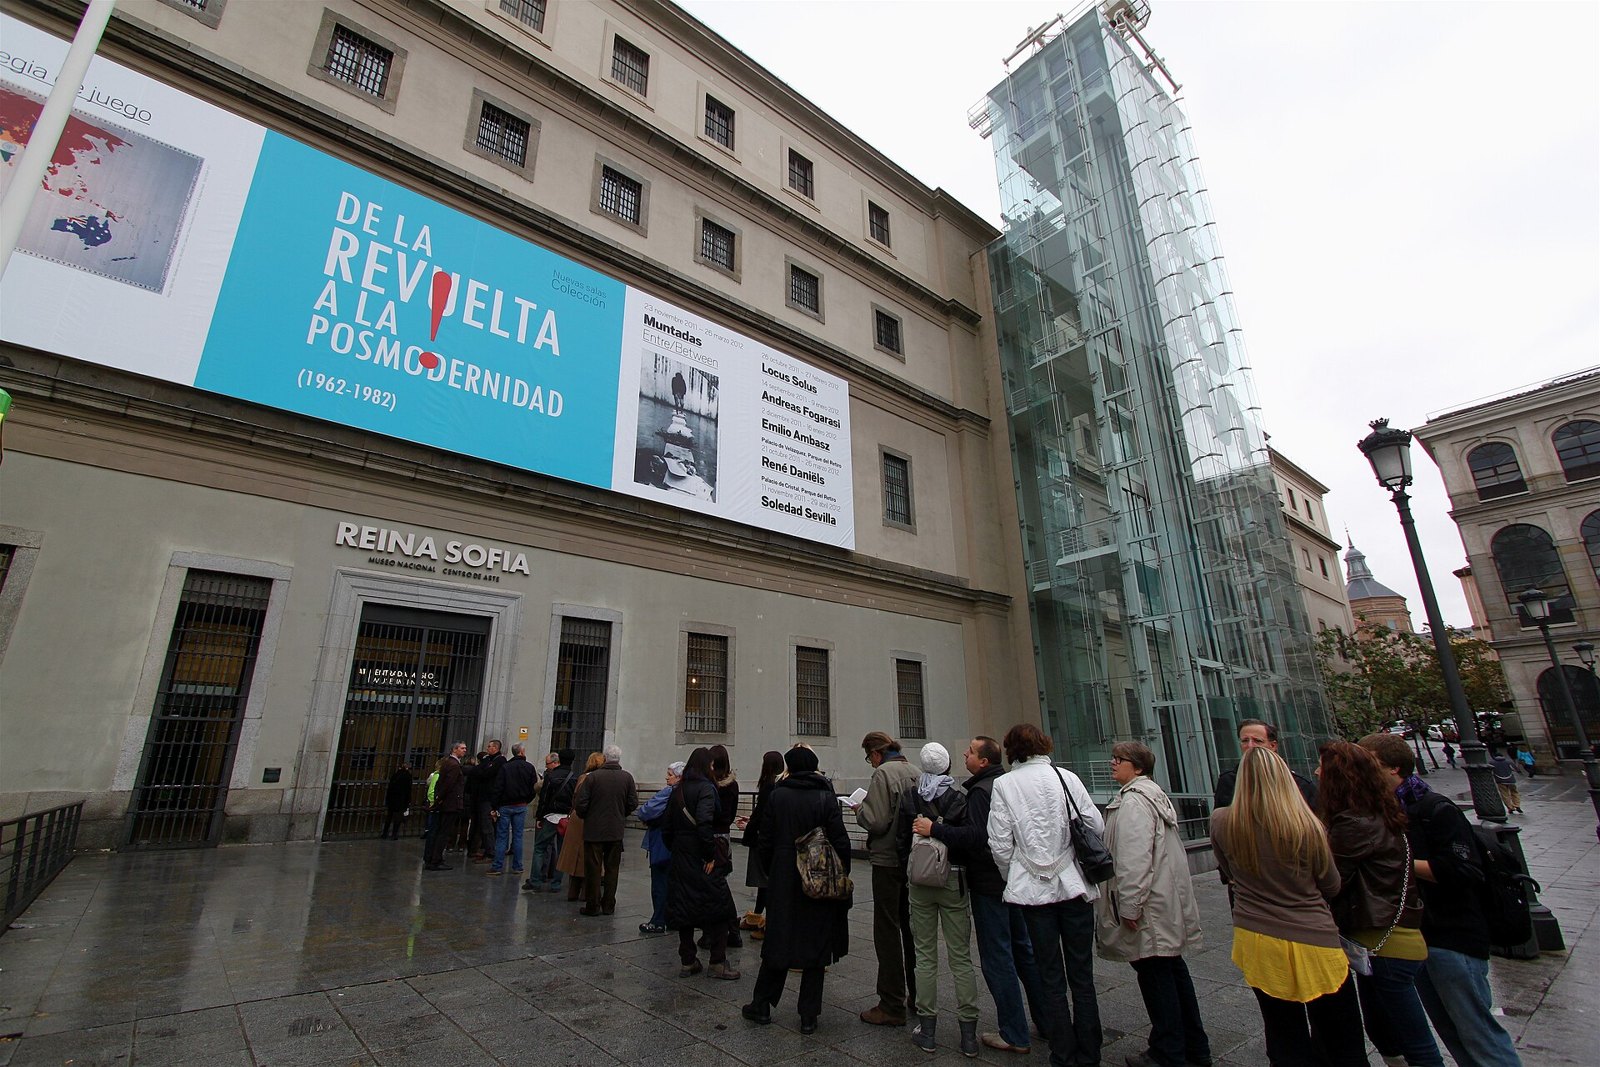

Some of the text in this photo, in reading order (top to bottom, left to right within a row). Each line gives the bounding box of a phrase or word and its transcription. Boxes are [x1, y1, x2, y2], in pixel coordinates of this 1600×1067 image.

[88, 86, 152, 122] juego
[335, 191, 433, 258] DE LA
[551, 278, 606, 309] Colección
[553, 269, 607, 299] Nuevas salas
[313, 279, 397, 335] A LA
[643, 313, 703, 346] Muntadas
[644, 303, 653, 312] 23
[654, 307, 683, 324] noviembre
[684, 319, 698, 330] 2011
[713, 333, 729, 344] marzo
[730, 340, 744, 350] 2012
[642, 328, 719, 368] Entre/Between
[306, 313, 564, 418] POSMODERNIDAD
[761, 362, 818, 394] Locus Solus
[788, 364, 800, 374] 2011
[828, 382, 840, 391] 2012
[296, 367, 397, 412] (1962-1982)
[795, 393, 807, 403] 2011
[828, 406, 840, 415] 2012
[761, 390, 841, 429] Andreas Fogarasi
[766, 409, 790, 424] diciembre
[790, 417, 802, 427] 2011
[825, 432, 837, 441] 2012
[761, 418, 831, 451] Emilio Ambasz
[761, 436, 777, 447] Palacio
[807, 452, 822, 462] Parque
[829, 460, 842, 469] Retiro
[761, 444, 768, 452] 21
[768, 448, 788, 459] octubre
[812, 463, 827, 472] marzo
[827, 467, 840, 477] 2012
[761, 455, 825, 485] René Daniëls
[761, 475, 778, 485] Palacio
[784, 483, 801, 493] Cristal,
[801, 487, 816, 497] Parque
[823, 493, 837, 503] Retiro
[767, 487, 794, 499] noviembre
[794, 493, 806, 503] 2011
[818, 501, 829, 509] abril
[829, 503, 841, 513] 2012
[761, 495, 836, 525] Soledad Sevilla
[335, 521, 531, 576] REINA SOFIA
[368, 556, 500, 583] MUSEO NACIONAL CENTRO DE ARTE
